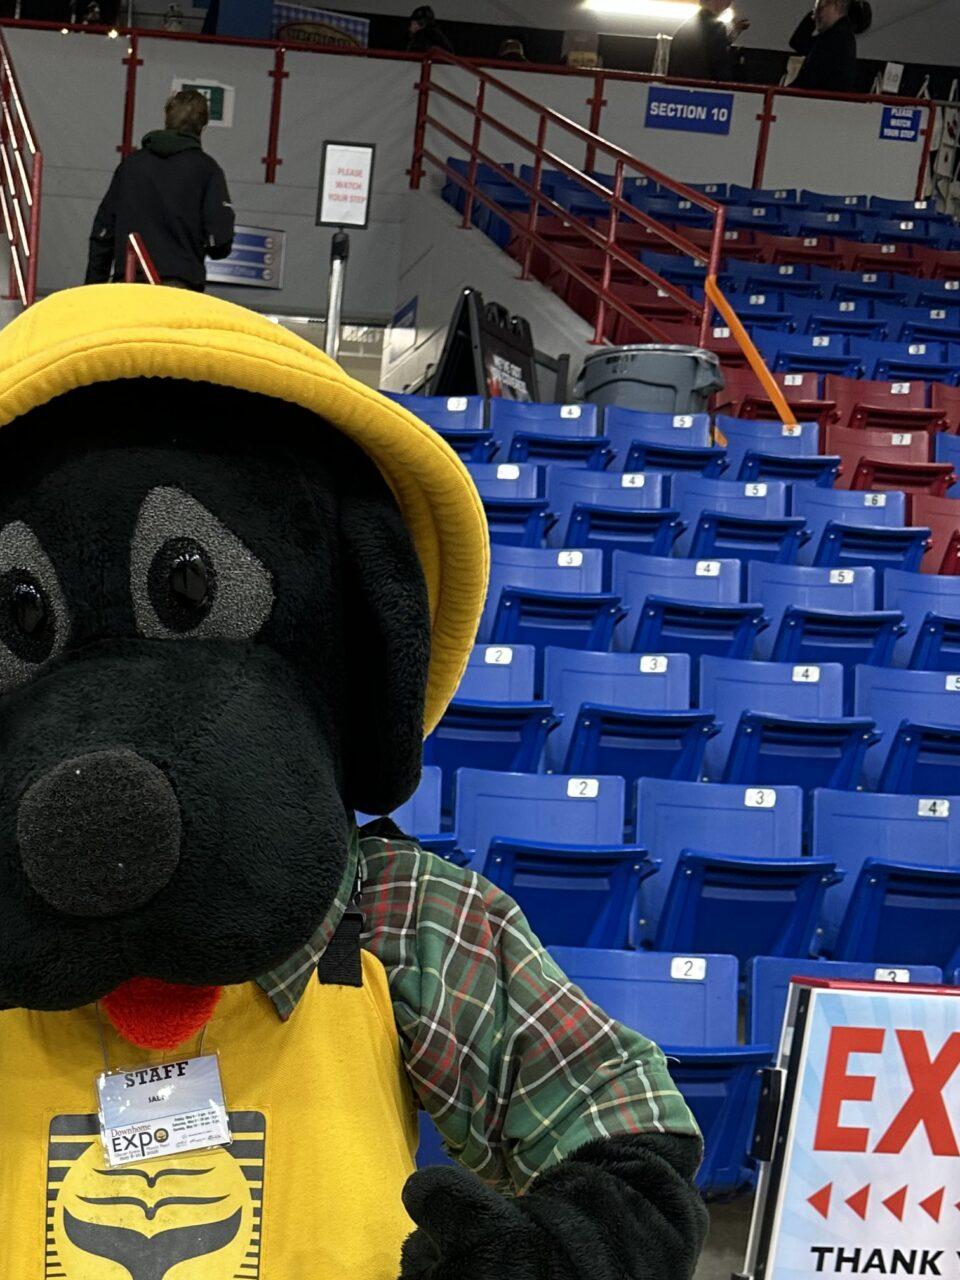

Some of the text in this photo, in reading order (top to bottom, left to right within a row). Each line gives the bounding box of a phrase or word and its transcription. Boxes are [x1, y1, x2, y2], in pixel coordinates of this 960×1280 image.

[650, 102, 728, 122] SECTION 10
[679, 416, 686, 427] 5
[899, 434, 904, 444] 7
[752, 485, 759, 496] 5
[871, 494, 878, 506] 6
[703, 563, 711, 573] 4
[837, 571, 845, 583] 5
[494, 649, 503, 663] 2
[649, 657, 658, 671] 3
[801, 668, 810, 680] 4
[579, 780, 588, 796] 2
[755, 789, 765, 806] 3
[928, 800, 938, 816] 4
[683, 960, 694, 977] 2
[125, 1061, 188, 1088] STAFF
[148, 1094, 166, 1103] SAL
[813, 1026, 960, 1157] EX
[111, 1124, 152, 1138] Downhome
[810, 1246, 945, 1276] THANK
